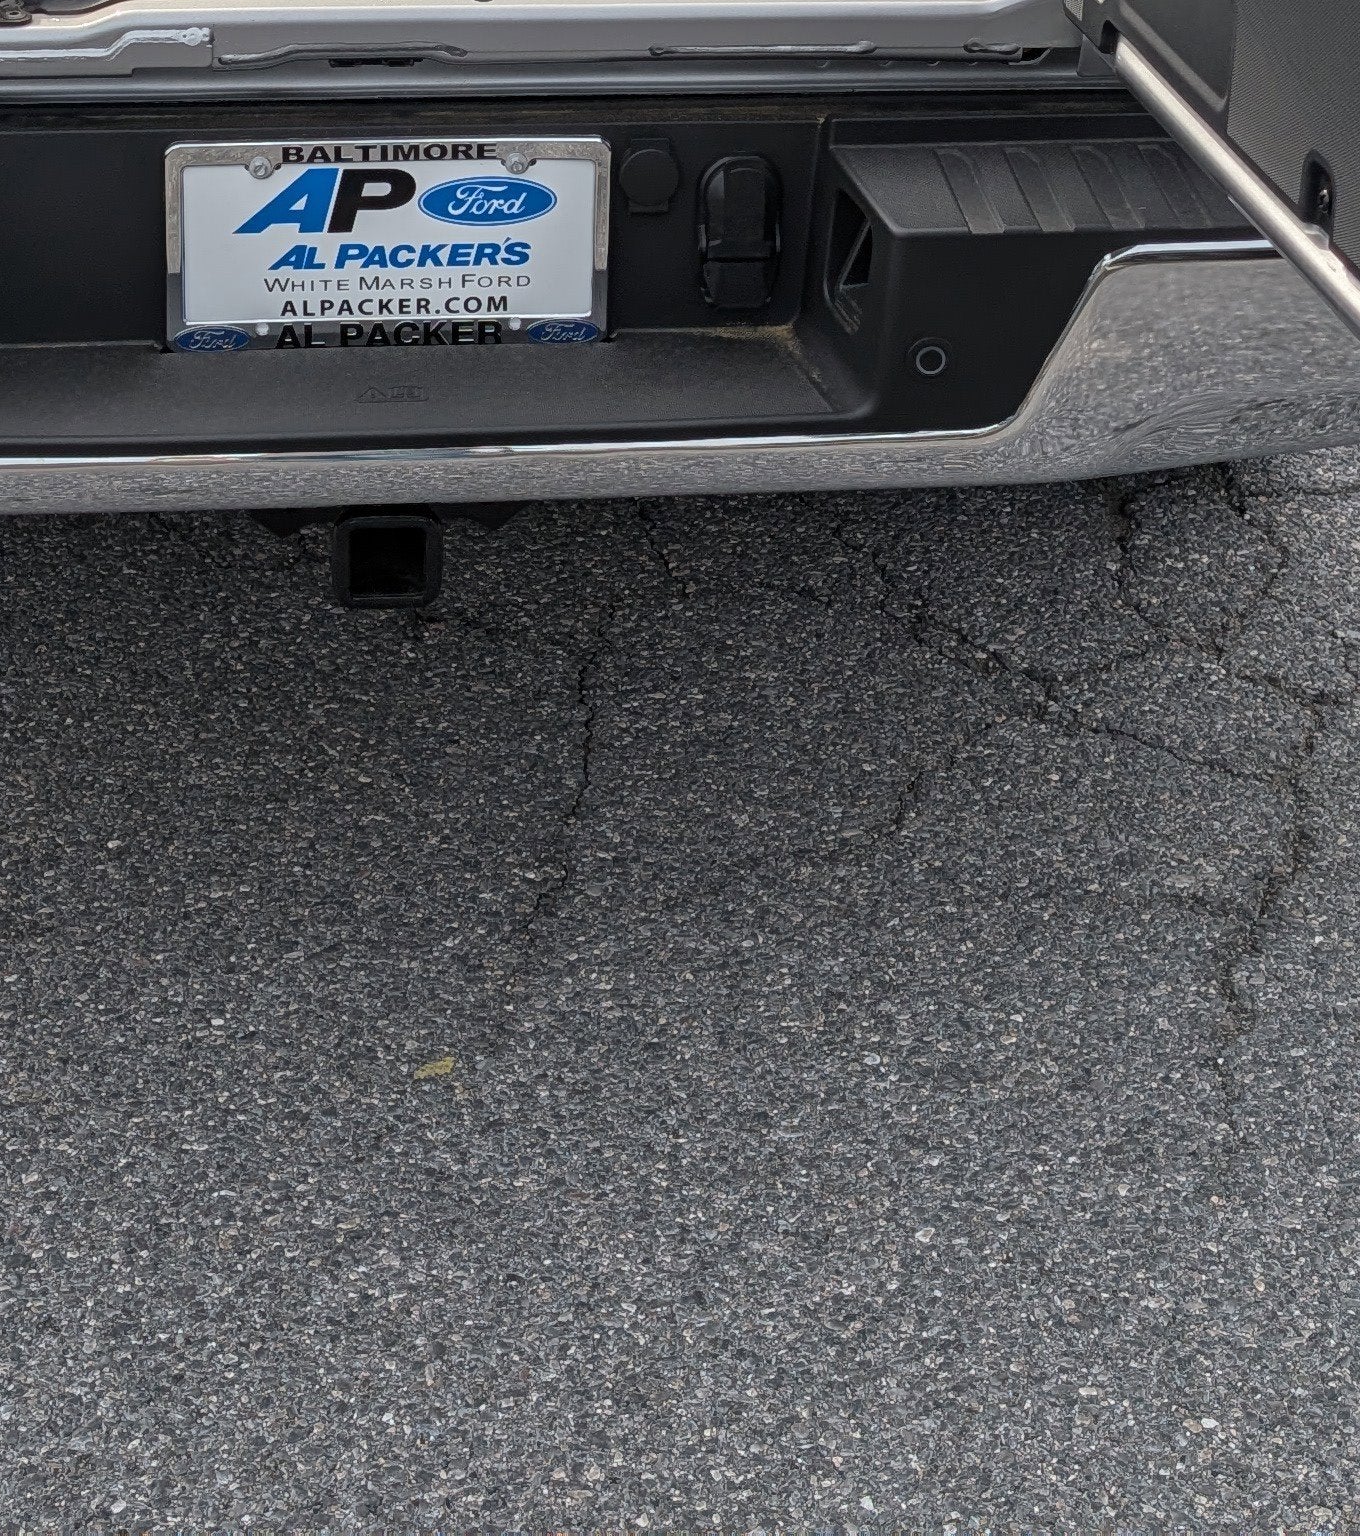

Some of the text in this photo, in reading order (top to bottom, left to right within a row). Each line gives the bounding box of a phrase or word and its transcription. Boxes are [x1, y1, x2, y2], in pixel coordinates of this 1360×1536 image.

[281, 143, 498, 164] BALTIMORE
[231, 167, 417, 234] AP
[447, 184, 528, 216] Ford
[267, 237, 532, 270] AL PACKER'S
[263, 273, 531, 293] WHITE MARSH FORD
[280, 295, 508, 317] ALPACKER.COM
[189, 330, 237, 349] Ford
[274, 318, 503, 349] AL PACKER
[541, 322, 587, 342] Ford
